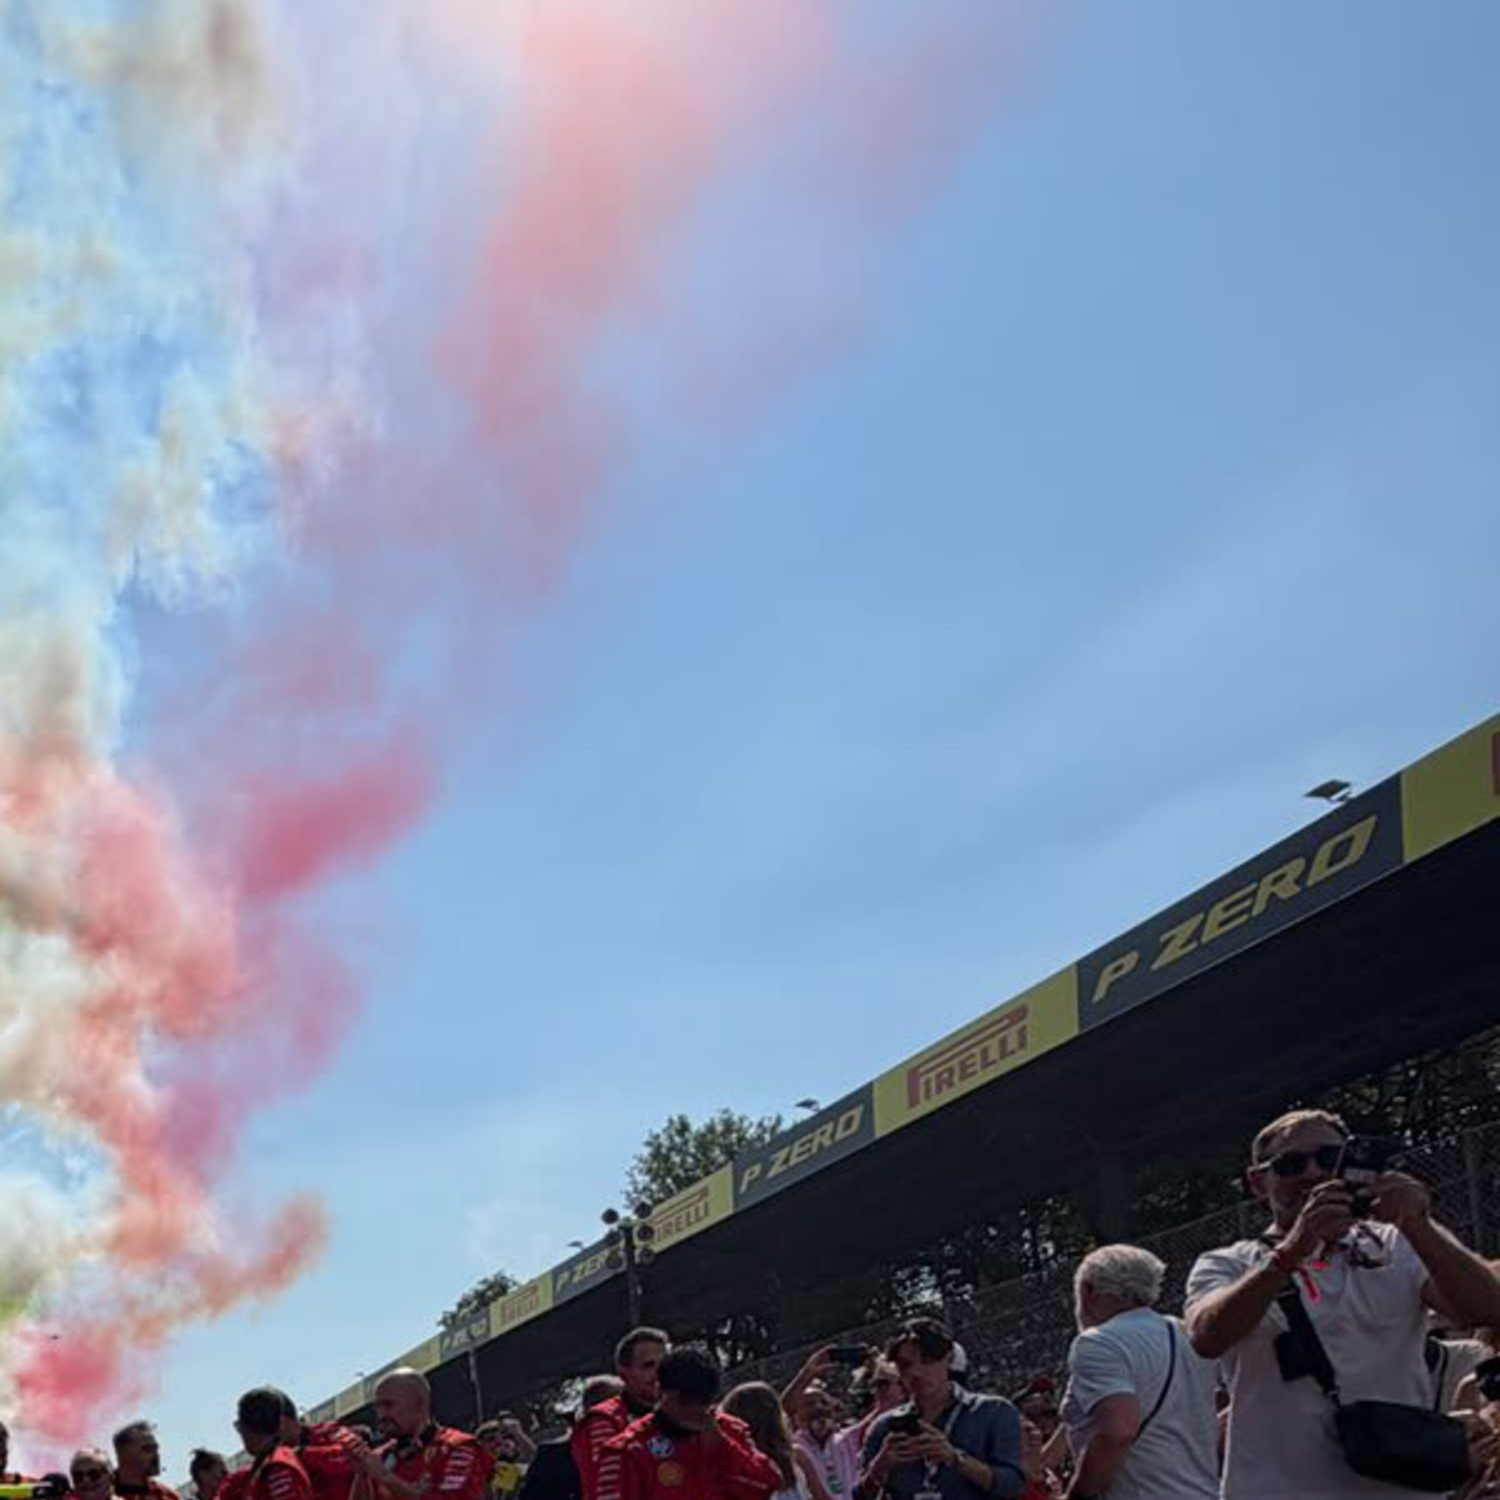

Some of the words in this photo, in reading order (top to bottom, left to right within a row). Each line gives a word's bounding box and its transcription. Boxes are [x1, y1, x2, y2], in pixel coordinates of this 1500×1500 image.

[1092, 950, 1140, 1004] P
[1150, 814, 1378, 973] ZERO
[906, 1005, 1029, 1109] PIRELLI
[740, 1163, 761, 1195] P
[767, 1104, 864, 1179] ZERO
